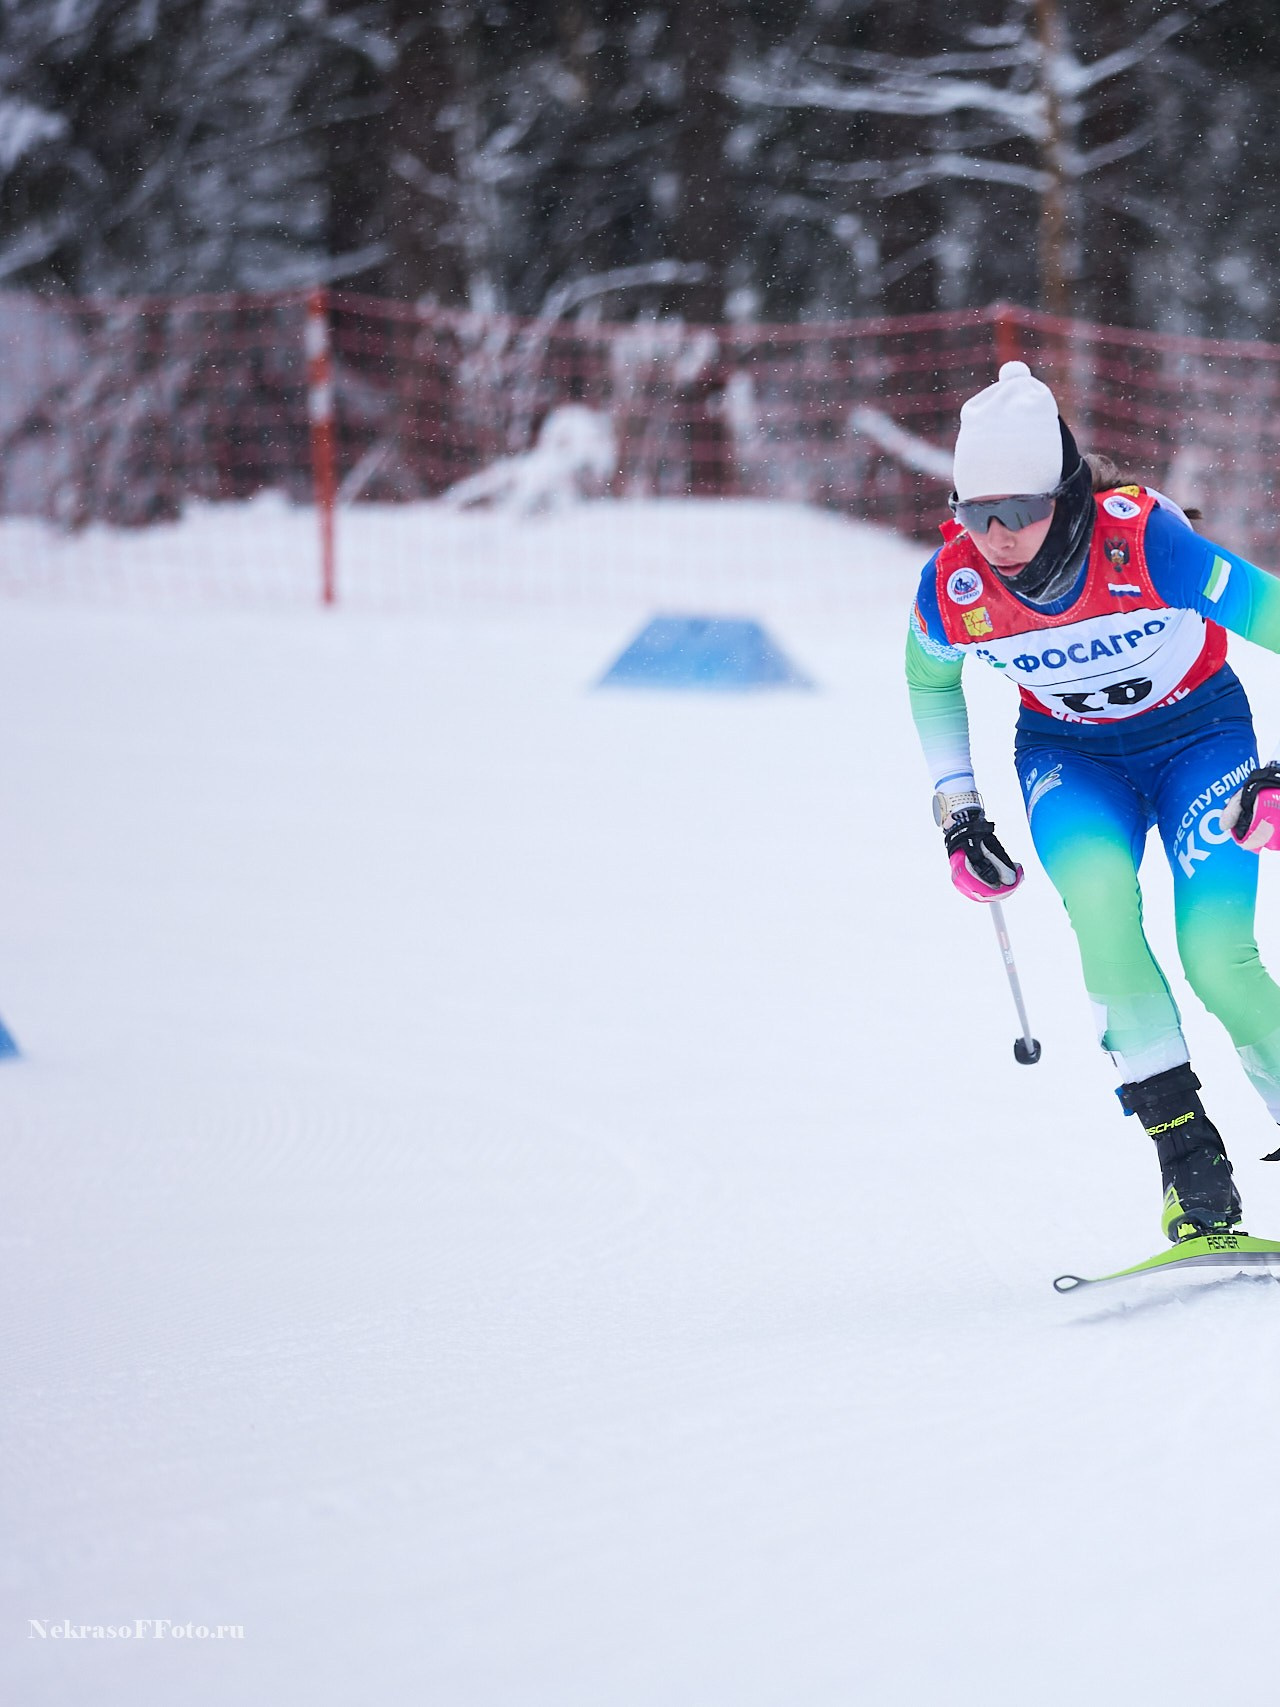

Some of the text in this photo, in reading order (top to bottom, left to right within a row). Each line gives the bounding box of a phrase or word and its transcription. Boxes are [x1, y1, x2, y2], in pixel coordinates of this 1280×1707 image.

[1012, 620, 1166, 673] ФОСАГРО
[1173, 756, 1257, 857] РЕСПУБЛИКА
[1177, 799, 1233, 880] КО
[1145, 1111, 1195, 1136] SCHER
[1206, 1236, 1240, 1251] FISCHER
